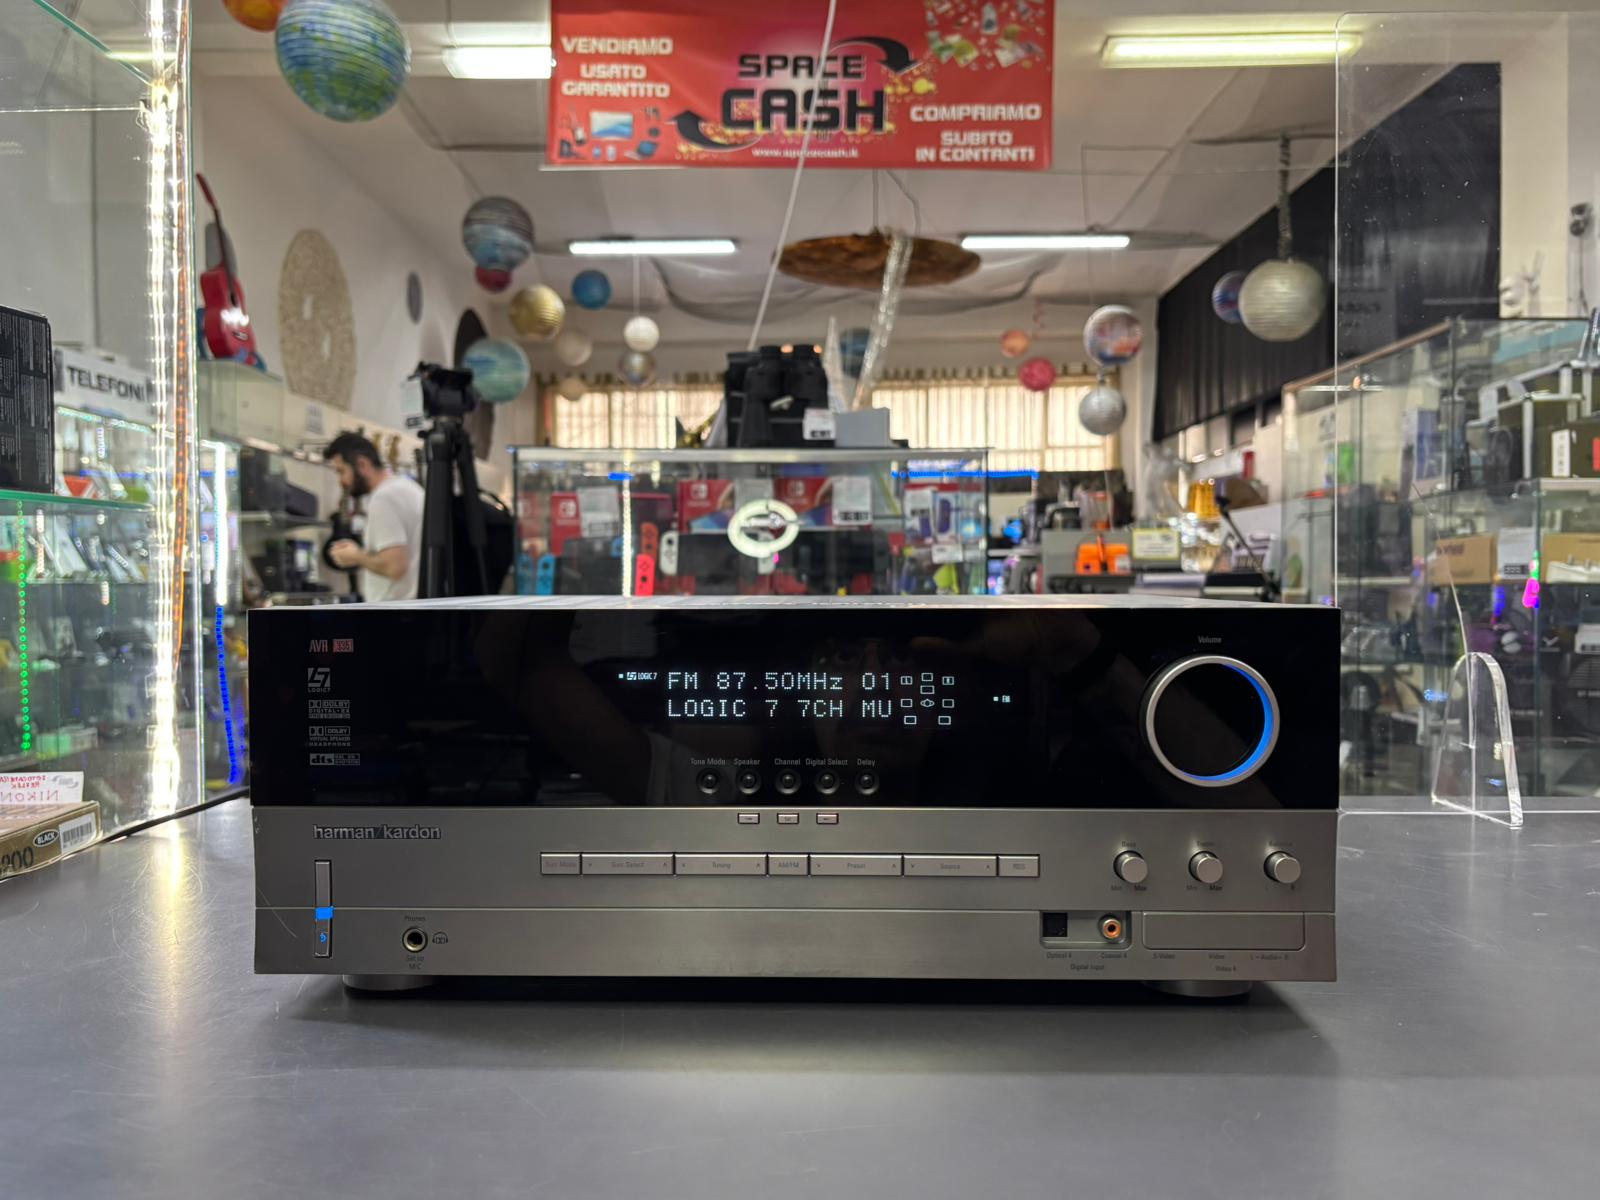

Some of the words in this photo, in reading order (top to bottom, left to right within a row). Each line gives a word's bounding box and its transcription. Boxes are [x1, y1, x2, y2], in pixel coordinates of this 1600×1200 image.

[561, 37, 673, 56] VENDIAMO
[579, 63, 647, 80] USATO
[738, 54, 865, 79] SPACE
[561, 81, 670, 98] GARANTITO
[722, 88, 886, 131] CASH
[909, 103, 1042, 122] COMPRIAMO
[940, 130, 1013, 146] SUBITO
[915, 147, 937, 162] IN
[939, 147, 1035, 162] CONTANTI
[66, 364, 145, 402] TELEFONI
[308, 639, 329, 653] AVR
[1197, 635, 1222, 644] Volume
[668, 671, 699, 690] FM
[716, 671, 844, 690] 87.50MHz
[668, 698, 747, 718] LOGIC
[765, 698, 779, 718] 7
[797, 698, 844, 718] 7CH
[861, 698, 892, 718] MU
[733, 758, 761, 767] Speaker
[774, 758, 801, 766] Channel
[805, 758, 826, 767] Digital
[827, 758, 848, 766] Select
[857, 758, 876, 767] Delay
[36, 832, 56, 845] BLACK
